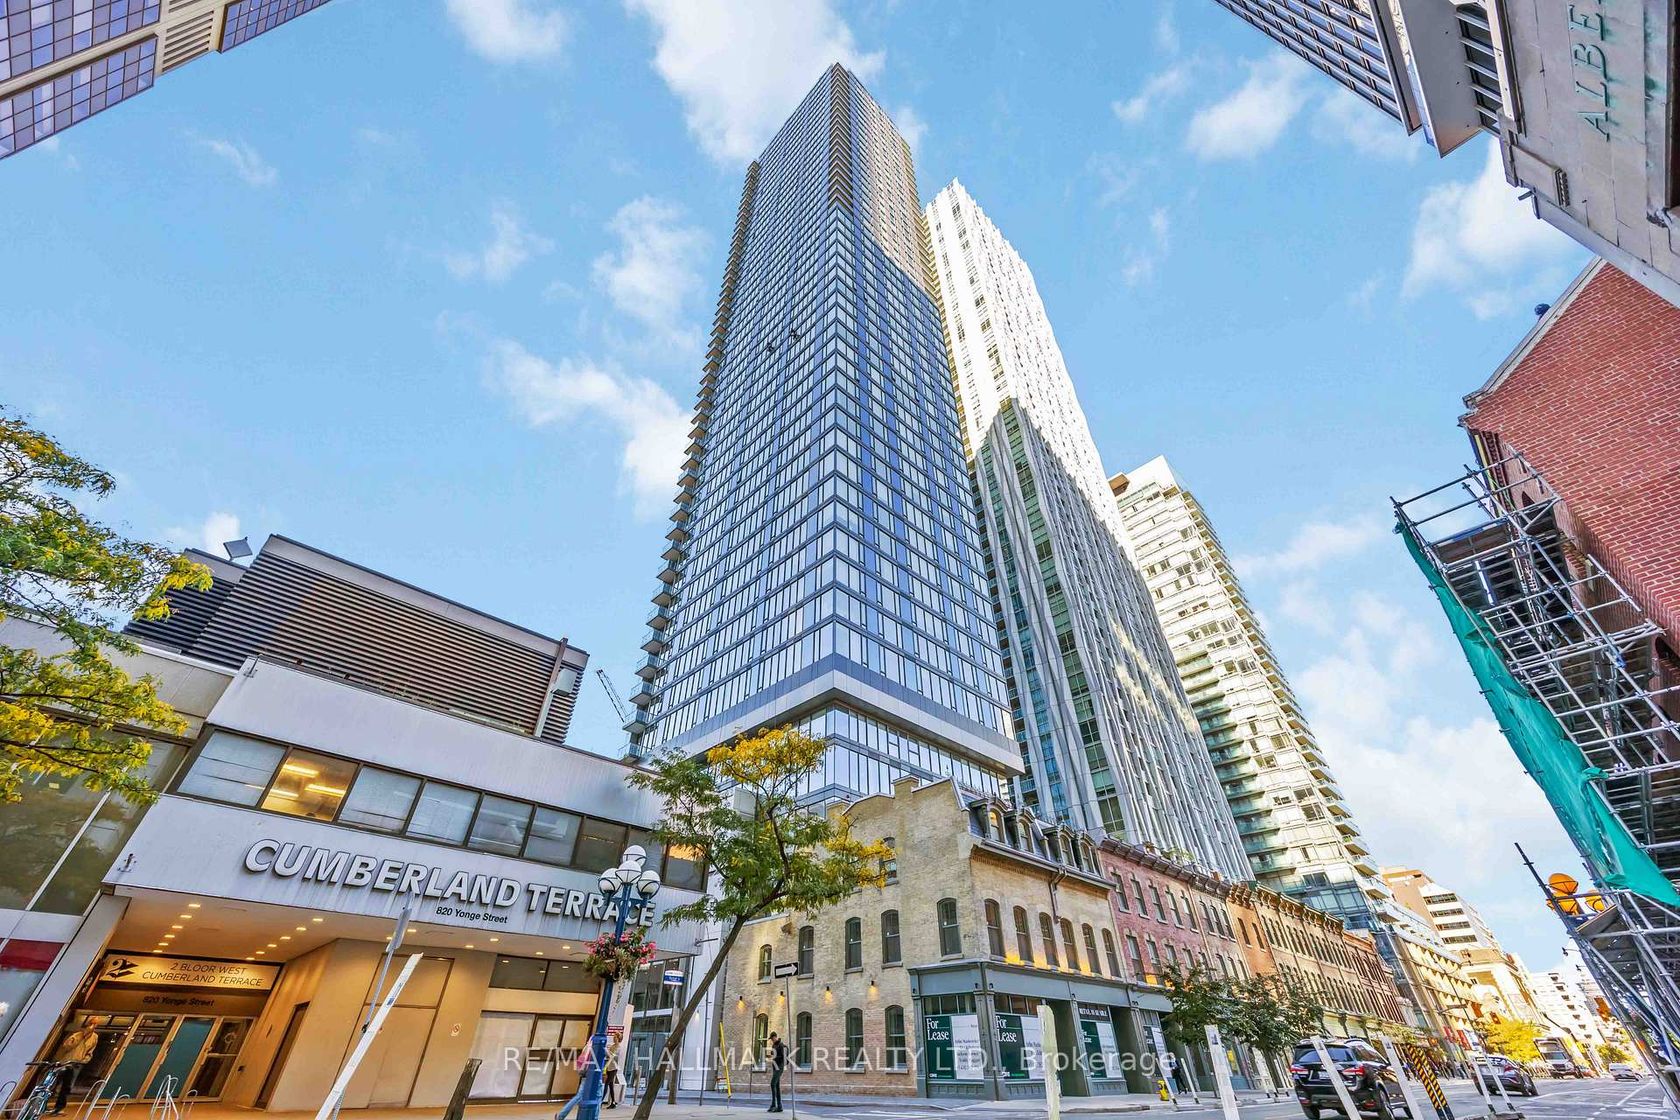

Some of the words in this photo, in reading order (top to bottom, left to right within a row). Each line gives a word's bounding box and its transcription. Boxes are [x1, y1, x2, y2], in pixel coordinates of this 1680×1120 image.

[1569, 0, 1610, 142] ALBE
[244, 838, 522, 908] CUMBERLAND
[527, 882, 657, 927] TERRACE
[435, 906, 453, 917] 820
[455, 909, 482, 921] Yonge
[482, 913, 508, 924] Street
[170, 962, 179, 971] 2
[180, 963, 218, 973] BLOOR
[218, 966, 247, 975] WEST
[142, 971, 216, 984] CUMBERLAND
[218, 975, 264, 987] TERRACE
[926, 1018, 939, 1030] For
[995, 1015, 1007, 1029] For
[927, 1029, 950, 1041] Lease
[997, 1028, 1018, 1043] Lease
